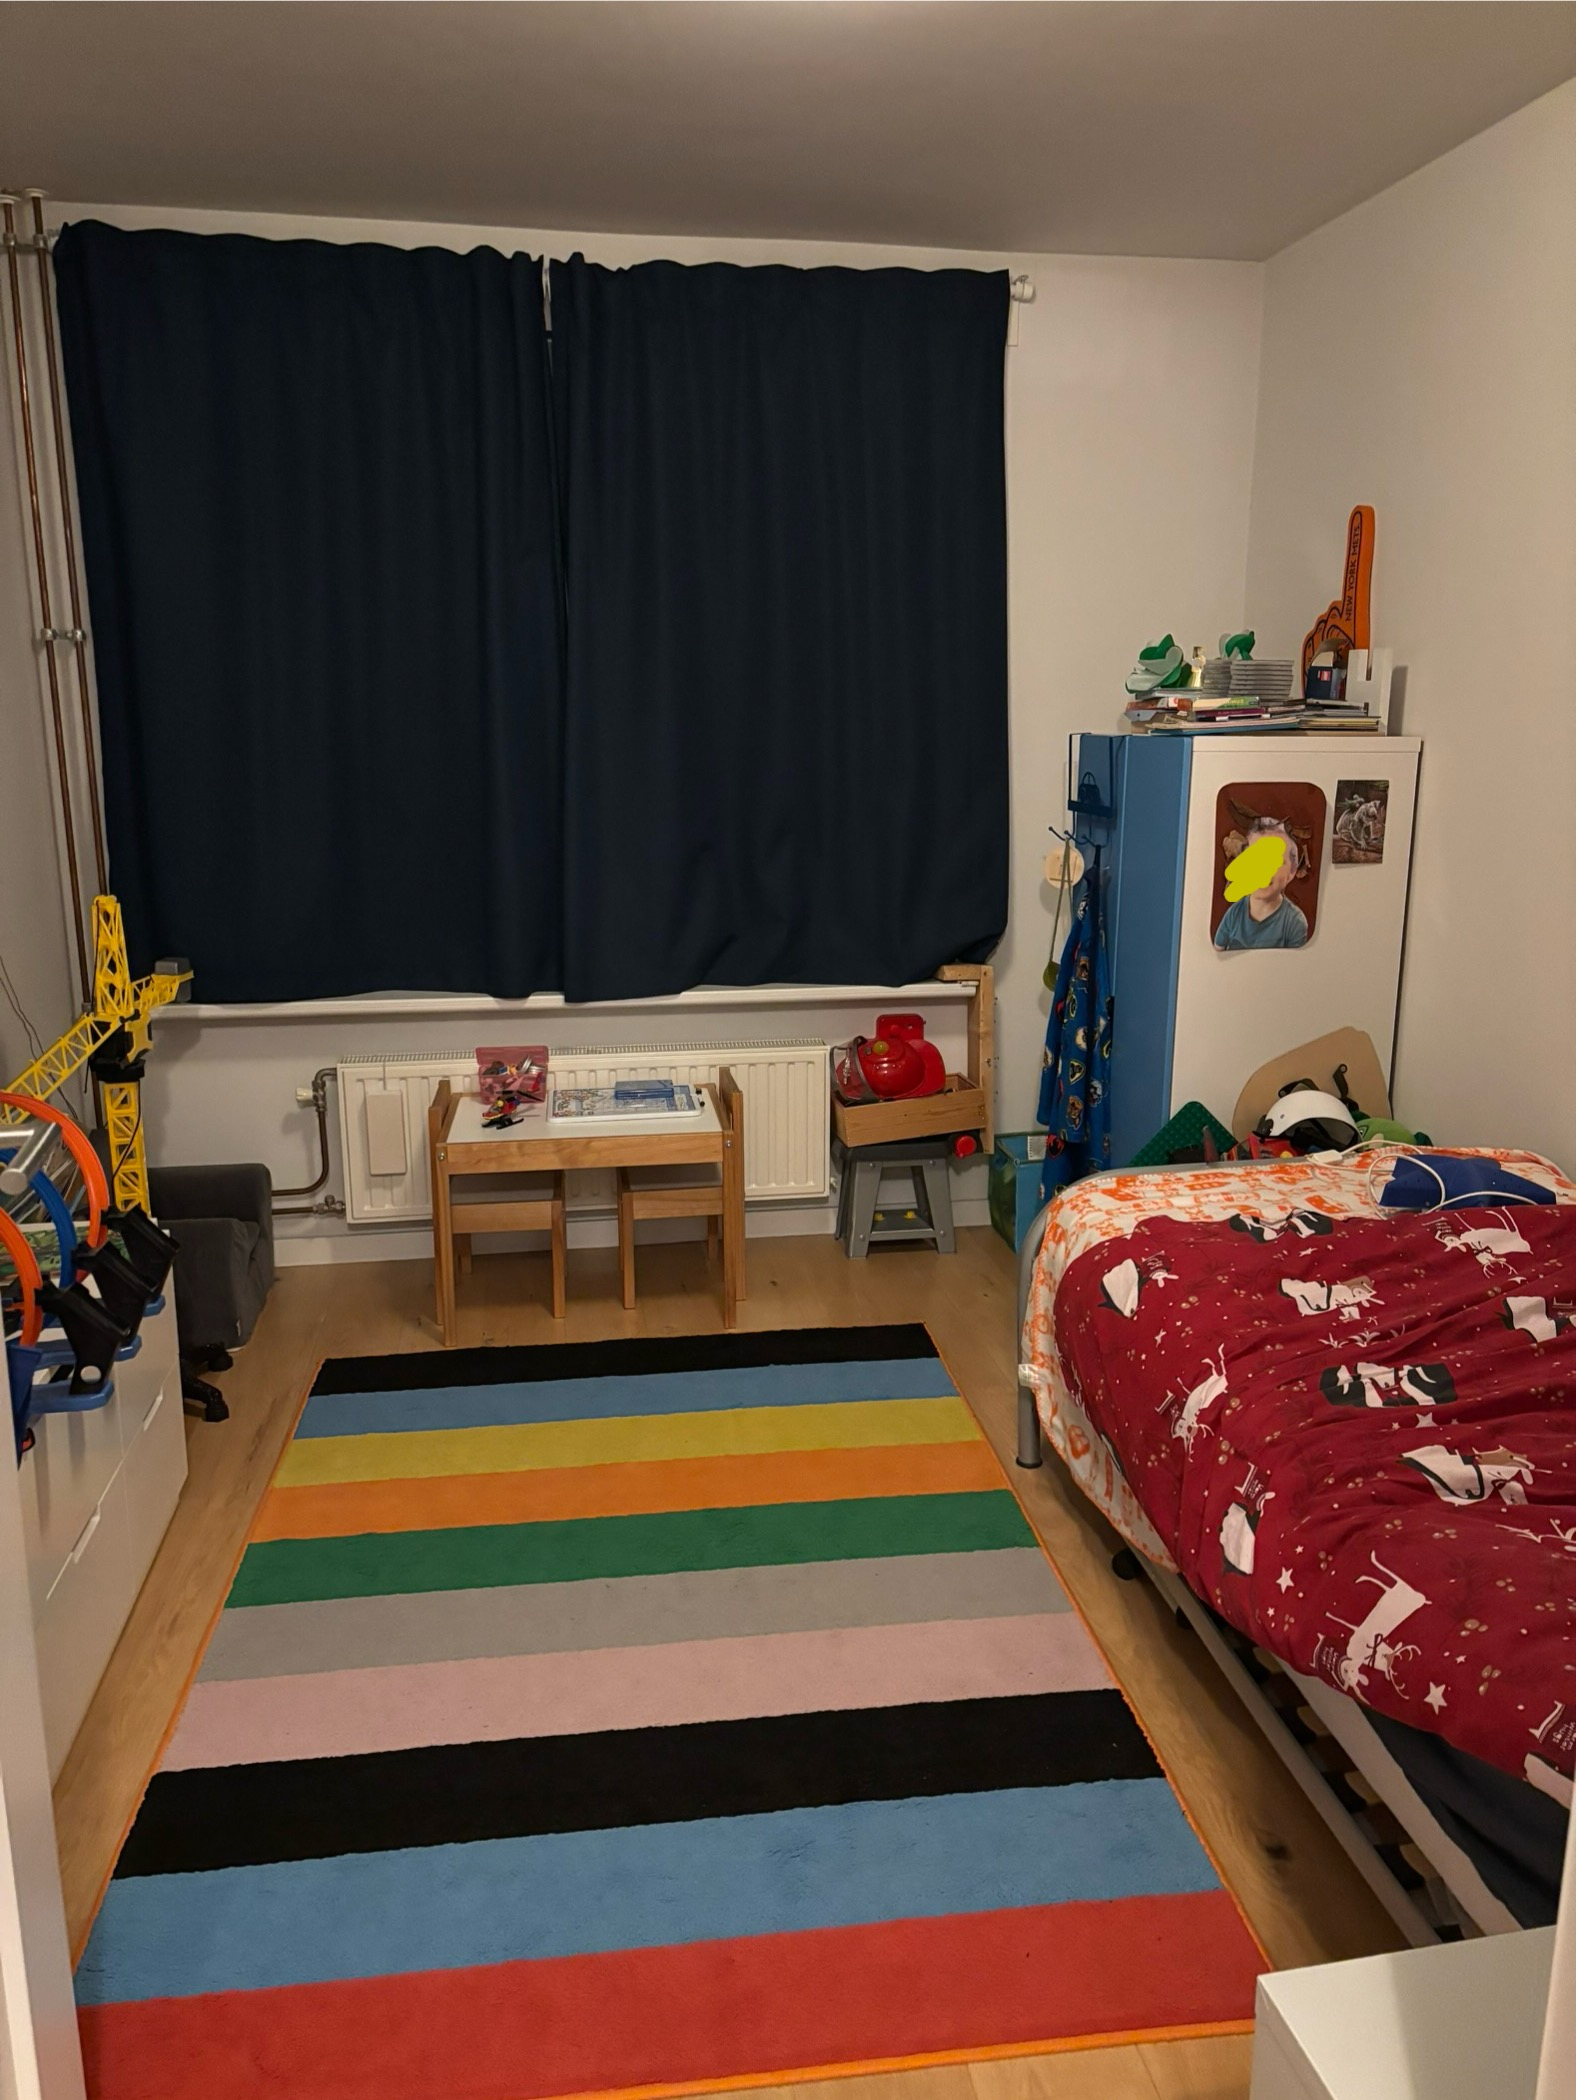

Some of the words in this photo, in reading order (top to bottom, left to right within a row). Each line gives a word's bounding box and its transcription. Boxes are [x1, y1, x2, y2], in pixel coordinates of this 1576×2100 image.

[1352, 525, 1361, 556] METS
[1347, 559, 1357, 592] YORK
[1345, 595, 1353, 621] NEW
[1552, 1723, 1569, 1744] hugs
[1559, 1721, 1576, 1751] winter
